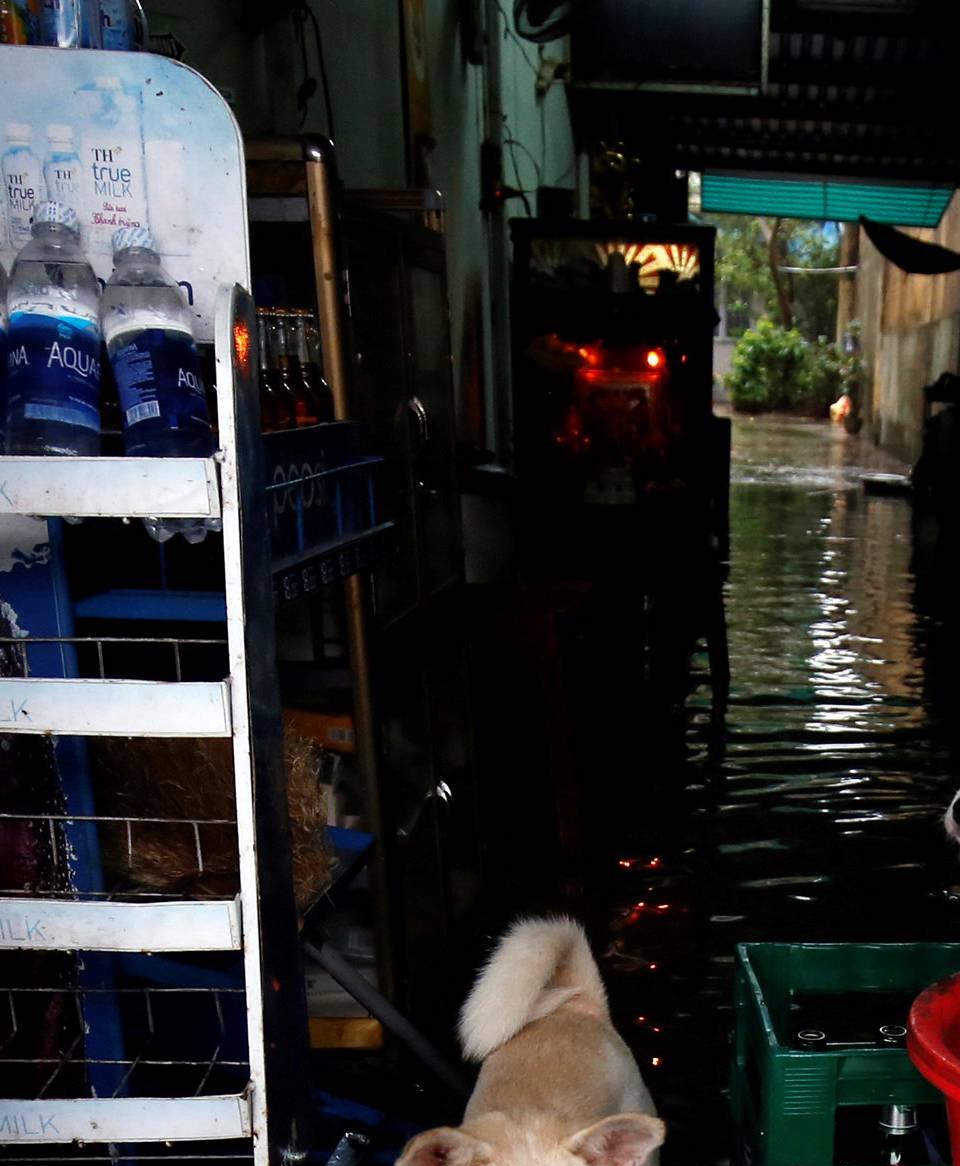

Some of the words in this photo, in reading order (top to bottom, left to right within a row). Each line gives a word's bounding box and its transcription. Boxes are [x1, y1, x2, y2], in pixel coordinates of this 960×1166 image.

[91, 148, 113, 162] TH
[54, 170, 72, 180] TH
[92, 162, 131, 182] true
[8, 174, 22, 185] TH
[8, 185, 35, 199] true
[94, 181, 133, 198] MILK
[8, 199, 35, 212] MILK
